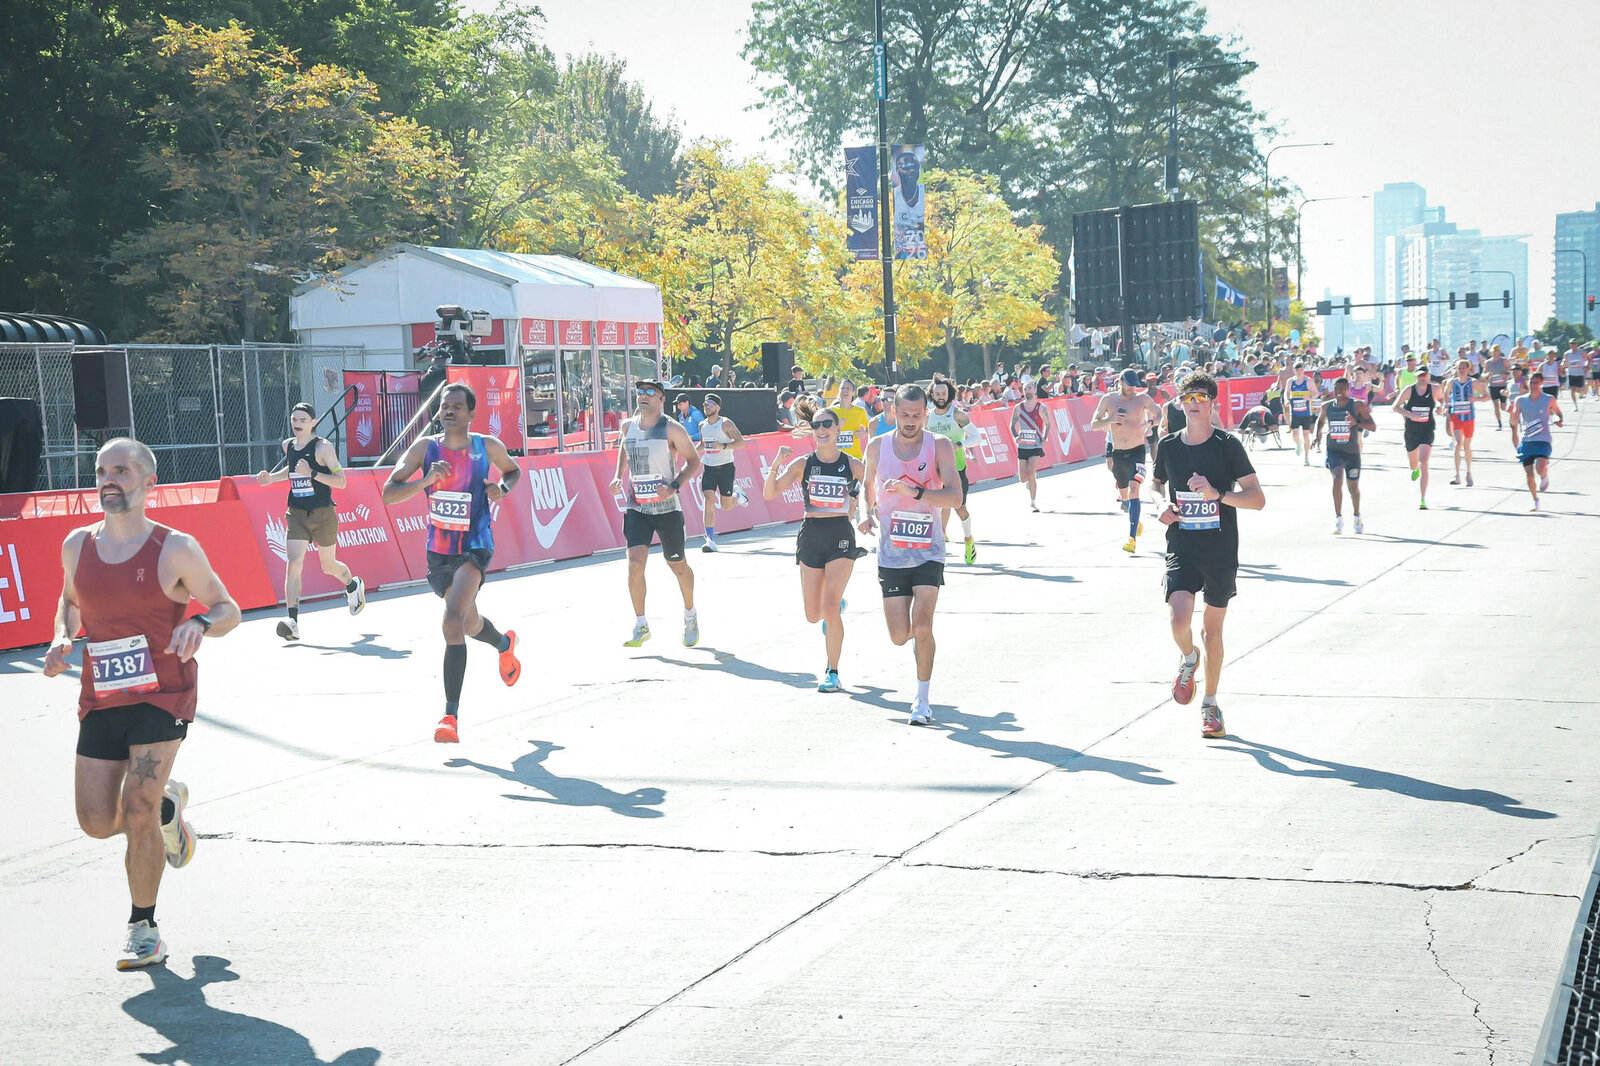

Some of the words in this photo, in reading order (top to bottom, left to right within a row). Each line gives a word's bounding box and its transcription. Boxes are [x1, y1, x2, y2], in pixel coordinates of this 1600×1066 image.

[529, 467, 568, 511] RUN
[639, 482, 662, 493] 2320
[817, 484, 844, 496] 5312
[437, 502, 468, 516] 4323
[1184, 502, 1217, 515] 2780
[397, 516, 427, 532] BANK
[901, 523, 930, 536] 1087
[337, 527, 388, 548] MARATHON
[100, 652, 145, 678] 7387
